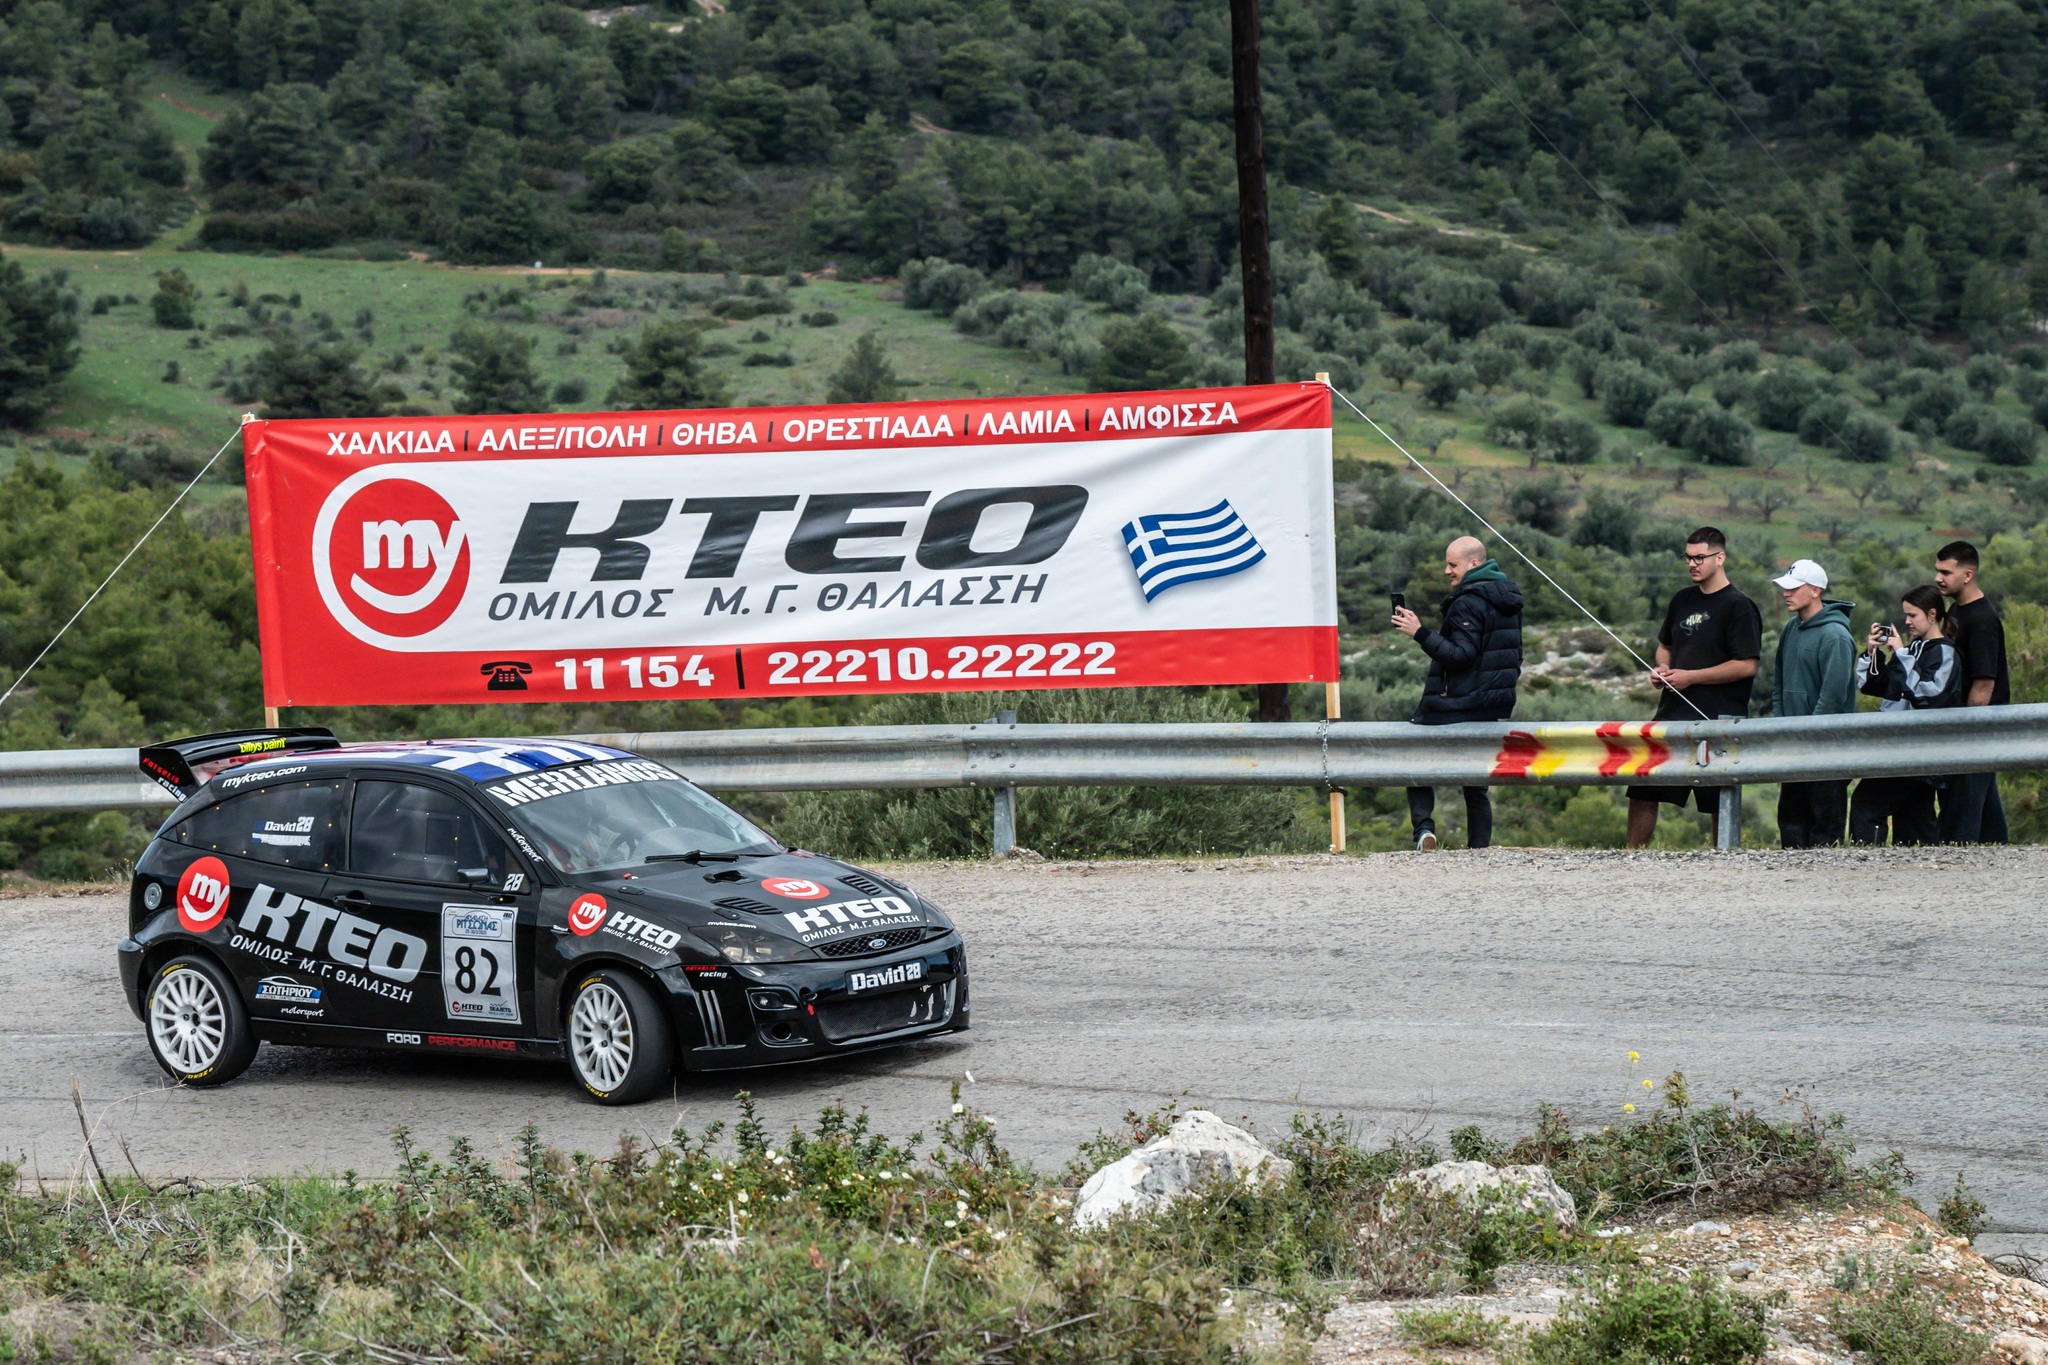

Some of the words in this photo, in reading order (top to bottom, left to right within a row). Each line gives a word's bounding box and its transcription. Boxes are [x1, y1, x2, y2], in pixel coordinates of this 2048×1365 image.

[327, 430, 455, 456] ΧΑΛΚΙΔΑ
[477, 424, 648, 452] ΑΛΕΞ/ΠΟΛΗ
[672, 421, 757, 446] ΘΗΒΑ
[783, 413, 954, 443] ΟΡΕΣΤΙΑΔΑ
[977, 408, 1075, 436] ΛΑΜΙΑ
[1100, 401, 1238, 432] ΑΜΦΙΣΣΑ
[499, 485, 1090, 584] ΚΤΕΟ
[350, 519, 467, 615] my
[487, 588, 674, 622] ΟΜΙΛΟΣ
[816, 573, 1049, 612] ΘΑΛΑΣΣΗ
[767, 641, 1116, 685] 22210.22222
[263, 737, 287, 752] paint
[158, 777, 187, 802] racing
[222, 765, 308, 789] mykteo.com
[486, 762, 680, 807] MERIANOS
[507, 827, 545, 863] motorsport
[181, 872, 231, 922] my
[502, 873, 525, 892] 28
[771, 880, 821, 897] my
[456, 918, 498, 931] ΡΙΤΣΩΝΑΣ
[571, 901, 607, 930] my
[802, 925, 845, 943] ΟΜΙΛΟΣ
[872, 915, 920, 926] ΘΑΛΑΣΣΗ
[238, 883, 428, 983] ΚΤΕΟ
[230, 934, 293, 965] ΟΜΙΛΟΣ
[335, 969, 413, 1004] ΘΑΛΑΣΣΗ
[455, 946, 501, 997] 82
[699, 971, 728, 979] racing
[261, 984, 313, 998] ΣΩΤΗΡΙΟΥ
[280, 1006, 325, 1020] motorsport
[386, 1033, 421, 1045] FORD
[428, 1035, 517, 1051] PERFORMANCE
